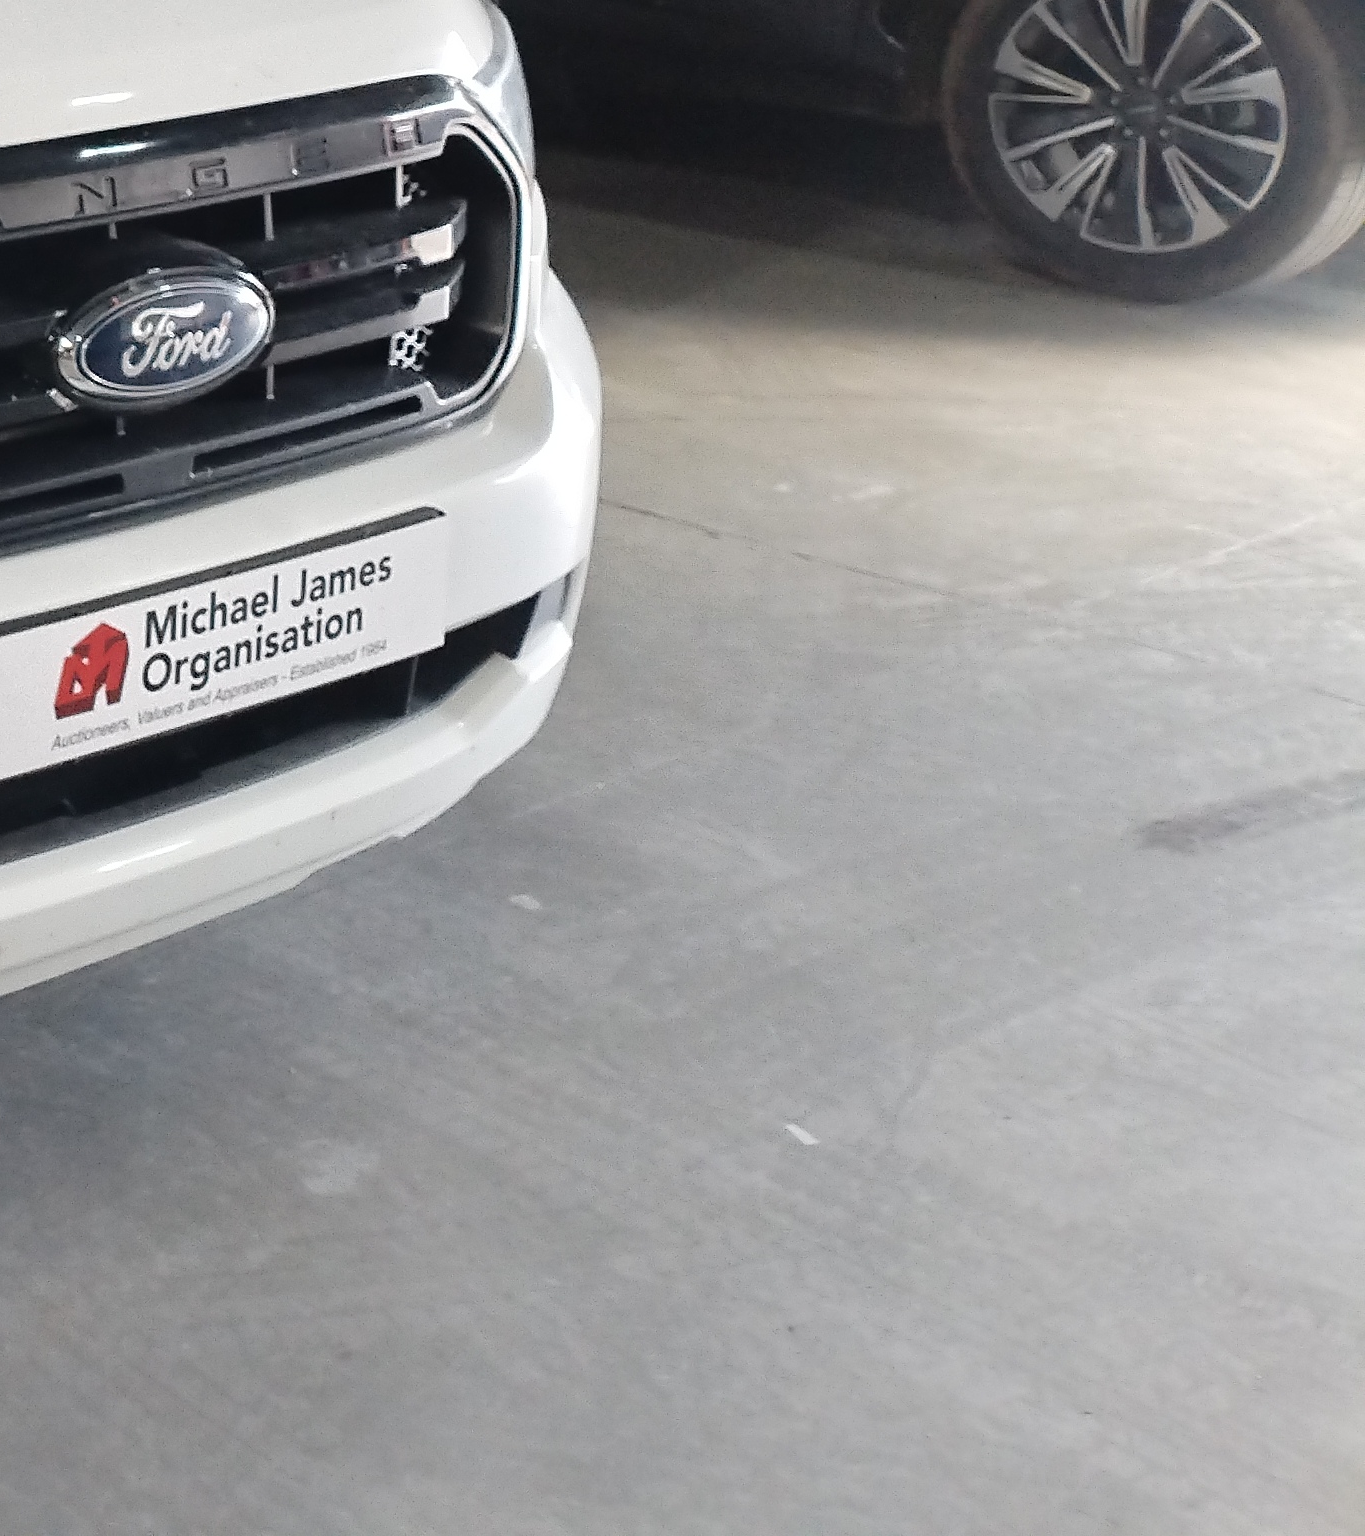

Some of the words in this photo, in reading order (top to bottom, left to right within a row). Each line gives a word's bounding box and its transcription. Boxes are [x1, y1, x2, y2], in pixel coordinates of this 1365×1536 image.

[122, 301, 233, 378] Ford
[145, 574, 279, 648] Michael
[291, 556, 391, 608] James
[142, 607, 363, 692] Organisation
[212, 674, 279, 703] Appraisers
[290, 648, 358, 681] Established
